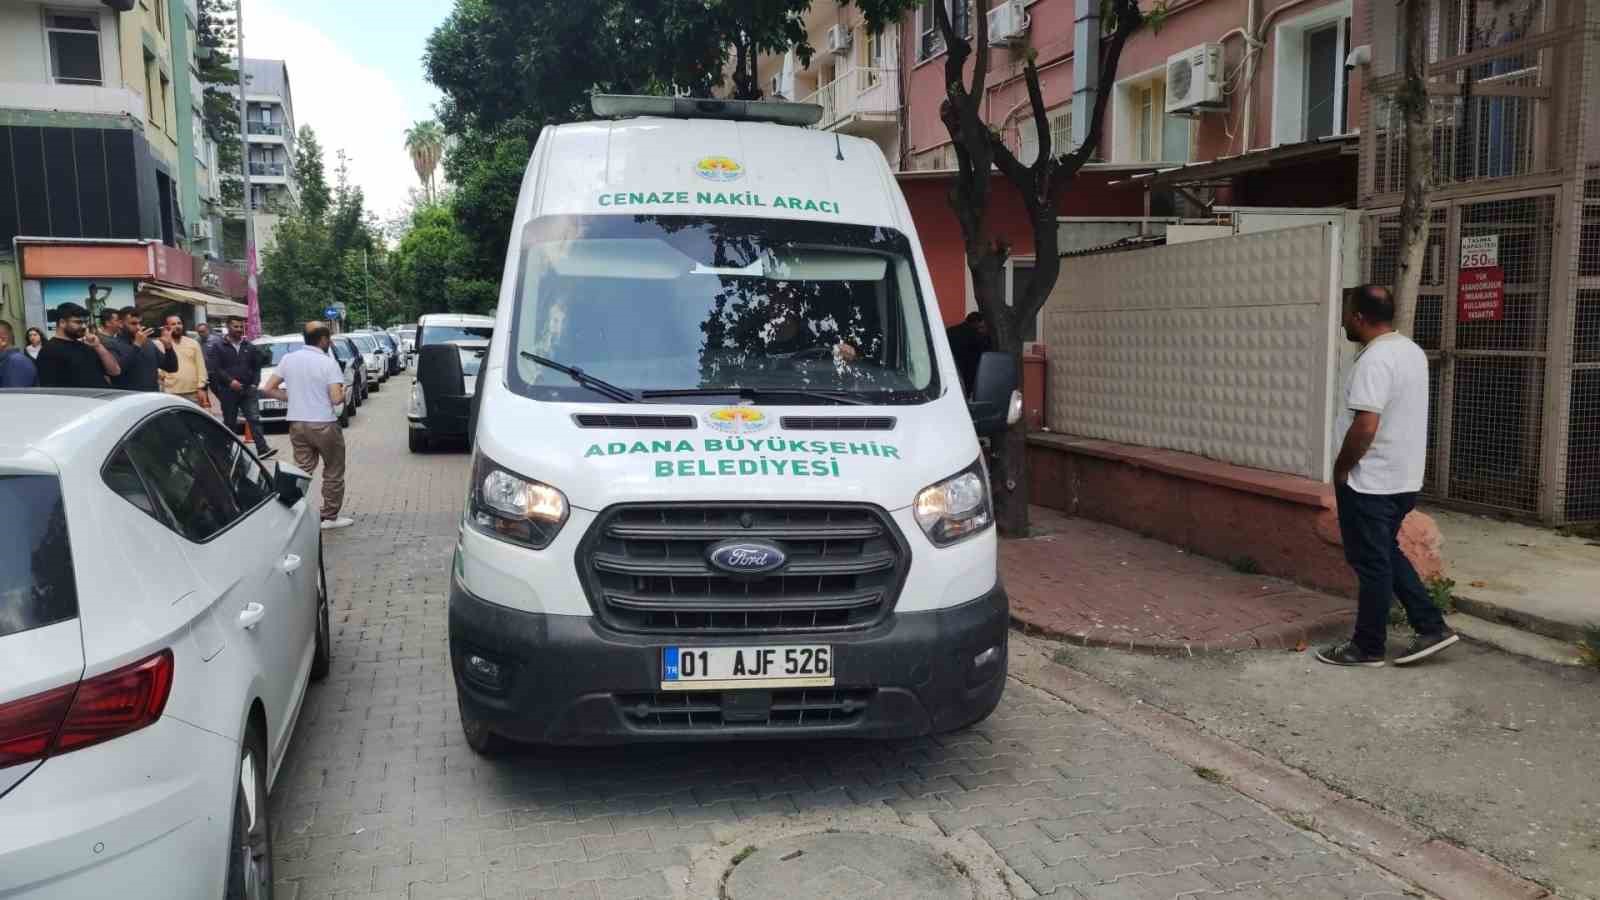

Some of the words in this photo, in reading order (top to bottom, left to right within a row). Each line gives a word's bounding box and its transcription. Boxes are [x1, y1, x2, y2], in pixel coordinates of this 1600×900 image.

[598, 191, 689, 207] CENAZE
[696, 190, 766, 206] NAKİL
[773, 195, 840, 214] ARACI
[1462, 254, 1488, 267] 250
[584, 439, 694, 457] ADANA
[704, 436, 901, 459] BÜYÜKŞEHİR
[655, 456, 840, 477] BELEDİYESİ
[728, 549, 767, 566] Ford
[681, 651, 708, 677] 01
[733, 650, 776, 676] AJF
[785, 648, 828, 674] 526
